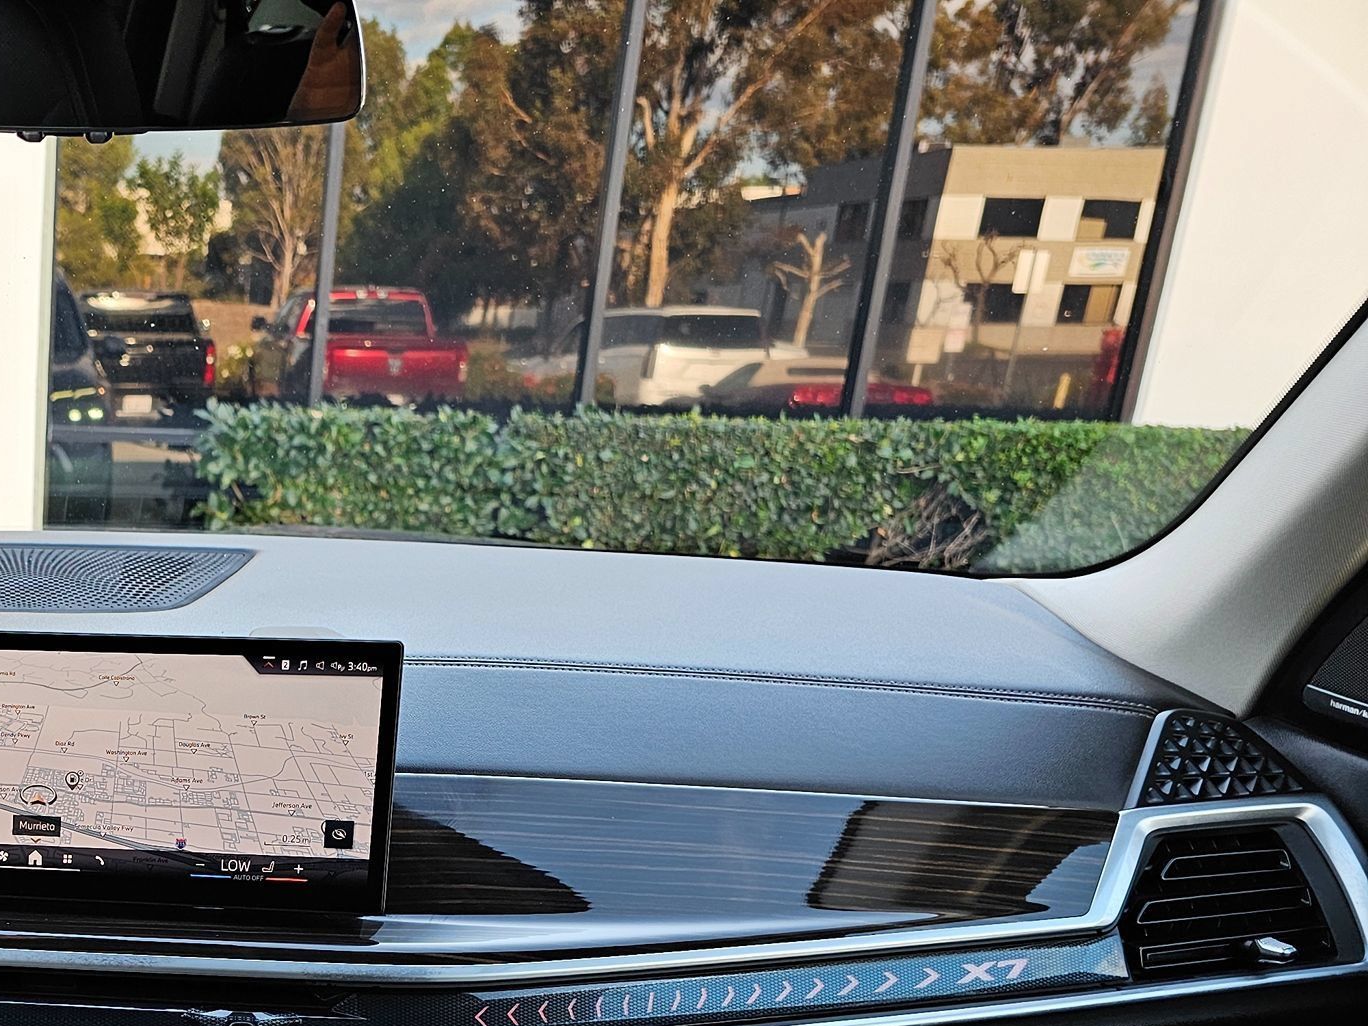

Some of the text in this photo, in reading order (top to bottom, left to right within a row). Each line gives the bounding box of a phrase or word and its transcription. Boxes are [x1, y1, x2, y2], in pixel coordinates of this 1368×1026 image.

[19, 821, 56, 831] Murrieta
[221, 859, 250, 871] LOW
[955, 957, 1029, 985] X7
